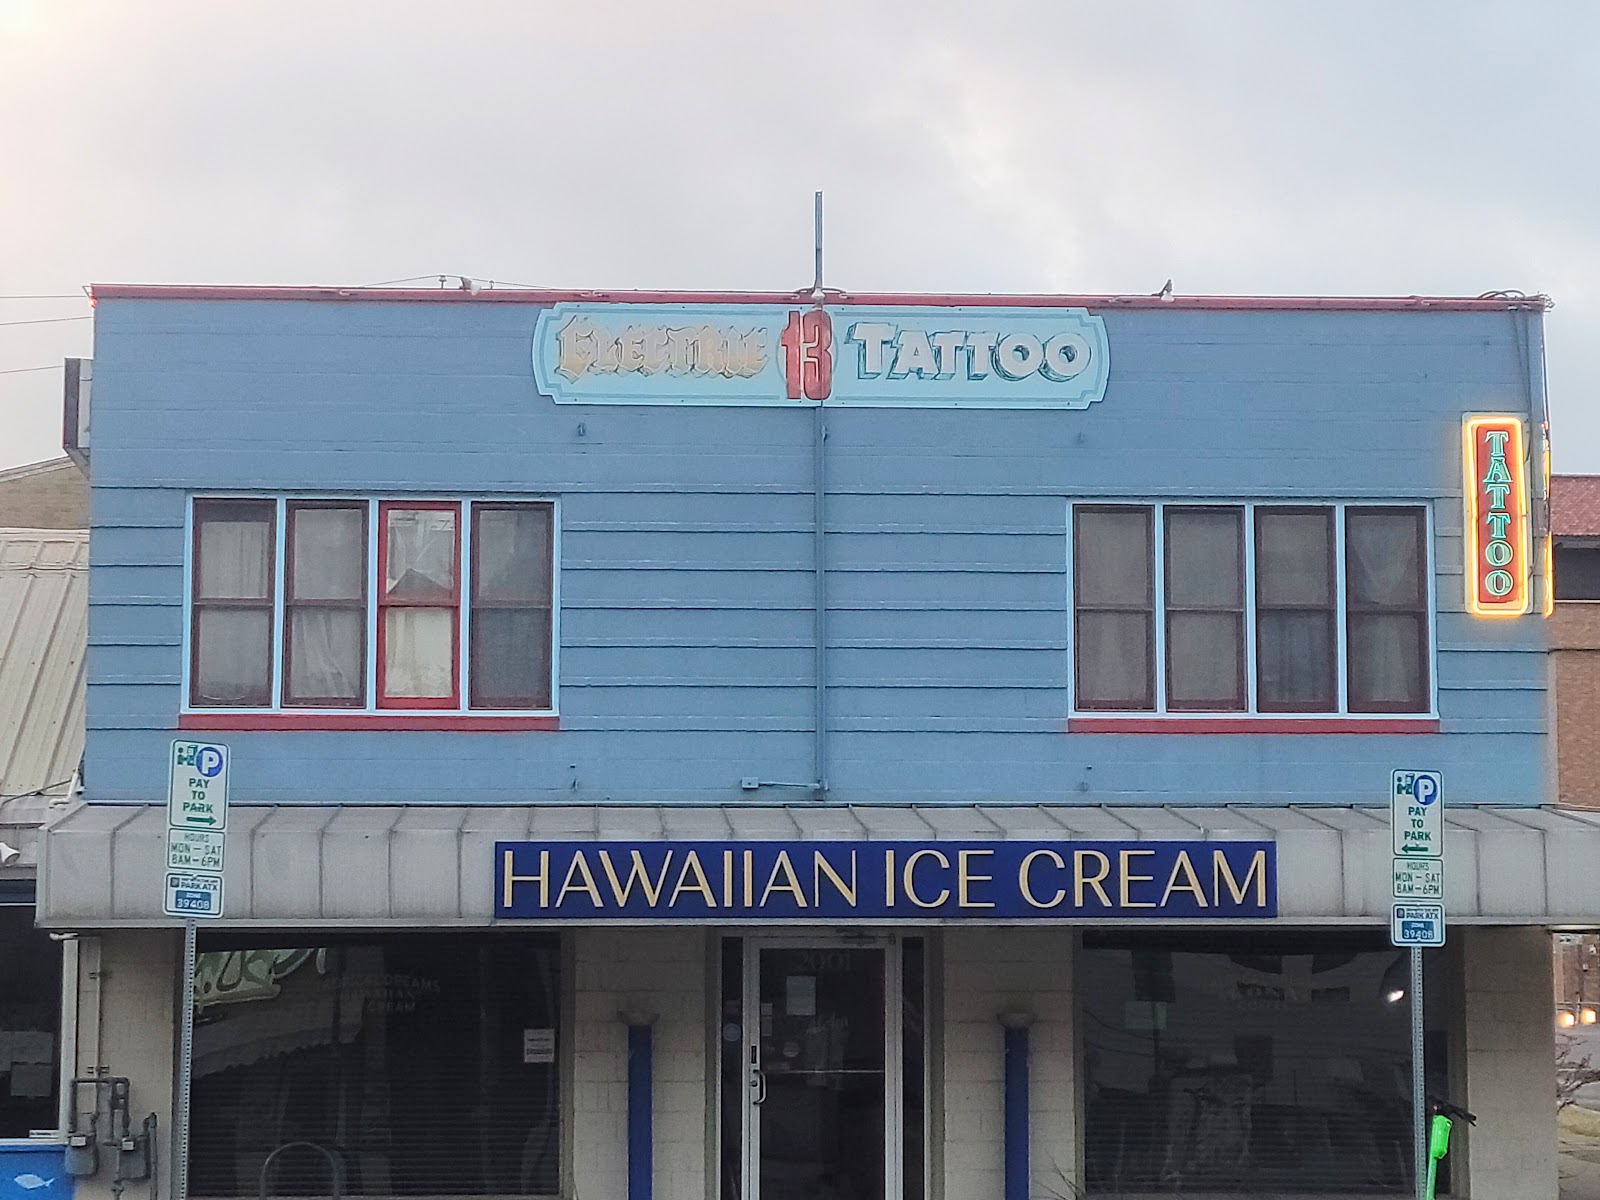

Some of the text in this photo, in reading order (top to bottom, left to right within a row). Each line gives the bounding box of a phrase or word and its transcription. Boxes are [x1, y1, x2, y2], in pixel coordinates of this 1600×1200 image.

[781, 310, 834, 400] 13
[846, 322, 1092, 382] TATTOO
[1483, 431, 1513, 596] TATTOO
[189, 778, 210, 788] PAY
[192, 791, 205, 800] TO
[183, 802, 213, 813] PARK
[1409, 807, 1427, 816] PAY
[1412, 819, 1423, 828] TO
[184, 833, 209, 842] HOURS
[1405, 831, 1431, 841] PARK
[171, 843, 190, 853] MON
[205, 845, 221, 855] SAT
[1407, 862, 1429, 870] HOURS
[503, 850, 1267, 908] HAWAIIAN ICE CREAM
[1396, 872, 1412, 882] MON
[1425, 873, 1440, 883] SAT
[177, 899, 209, 909] 39408
[1404, 930, 1433, 938] 39408
